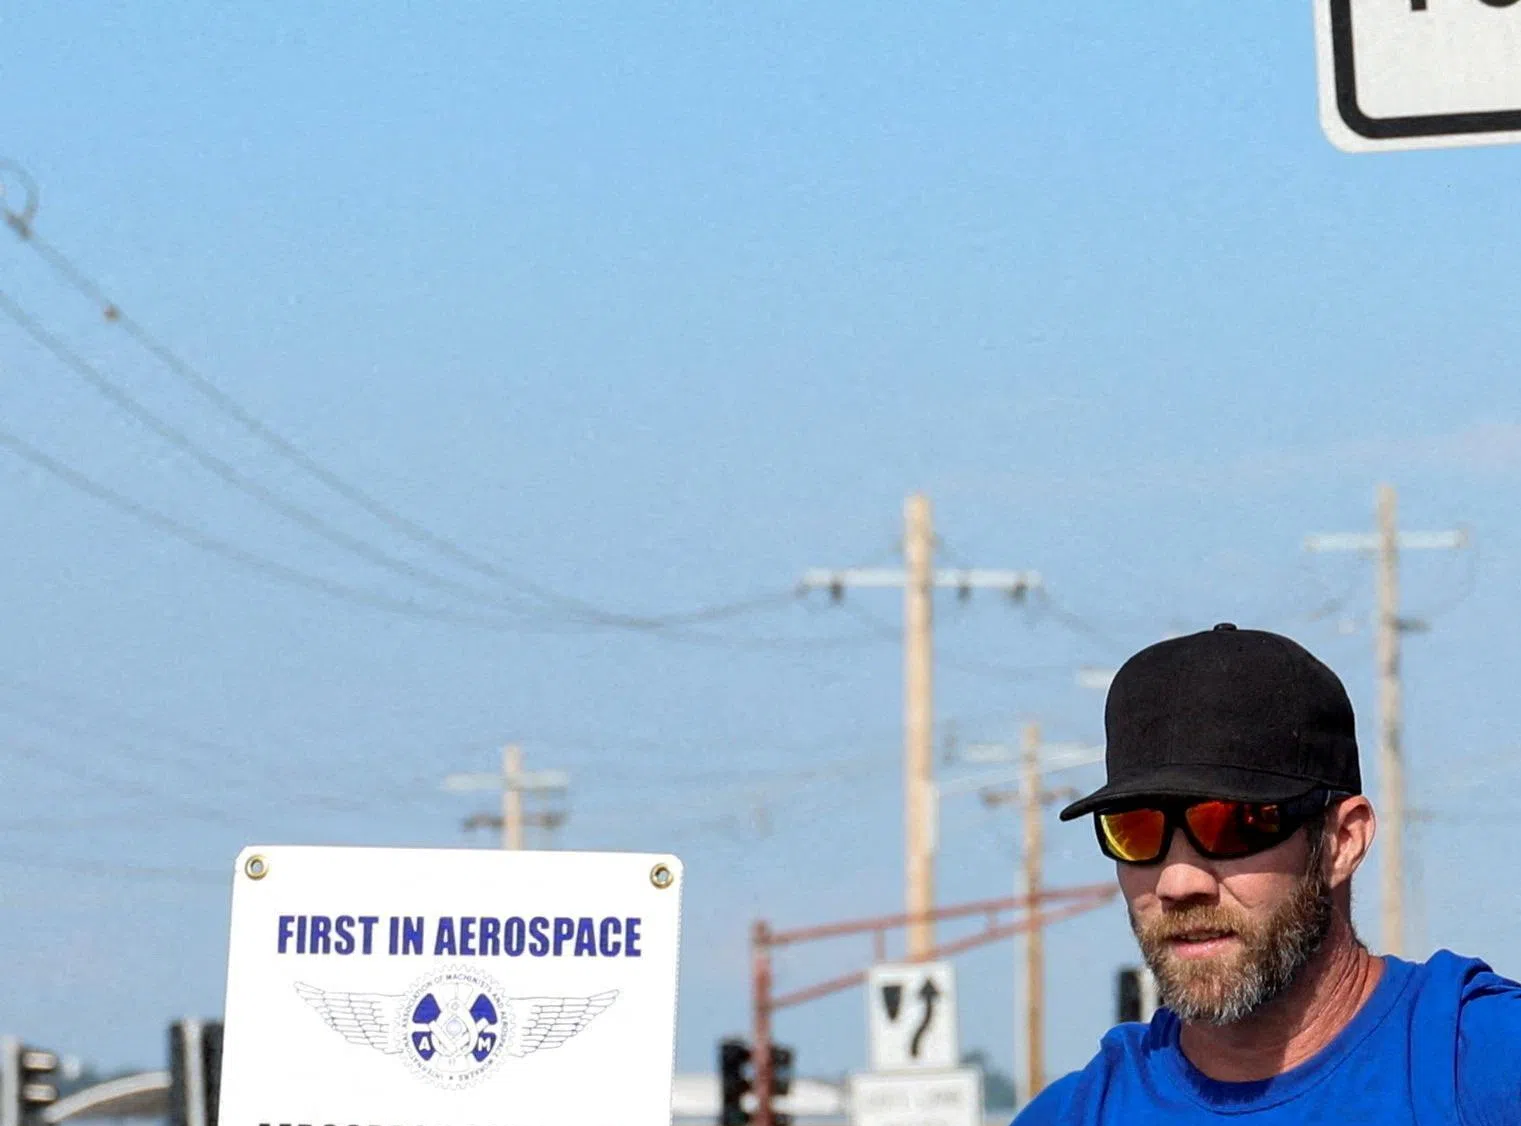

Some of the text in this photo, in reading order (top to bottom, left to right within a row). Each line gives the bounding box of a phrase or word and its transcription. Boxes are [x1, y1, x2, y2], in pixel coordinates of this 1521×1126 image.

[278, 916, 641, 956] FIRST IN AEROSPACE
[418, 1036, 492, 1051] A M
